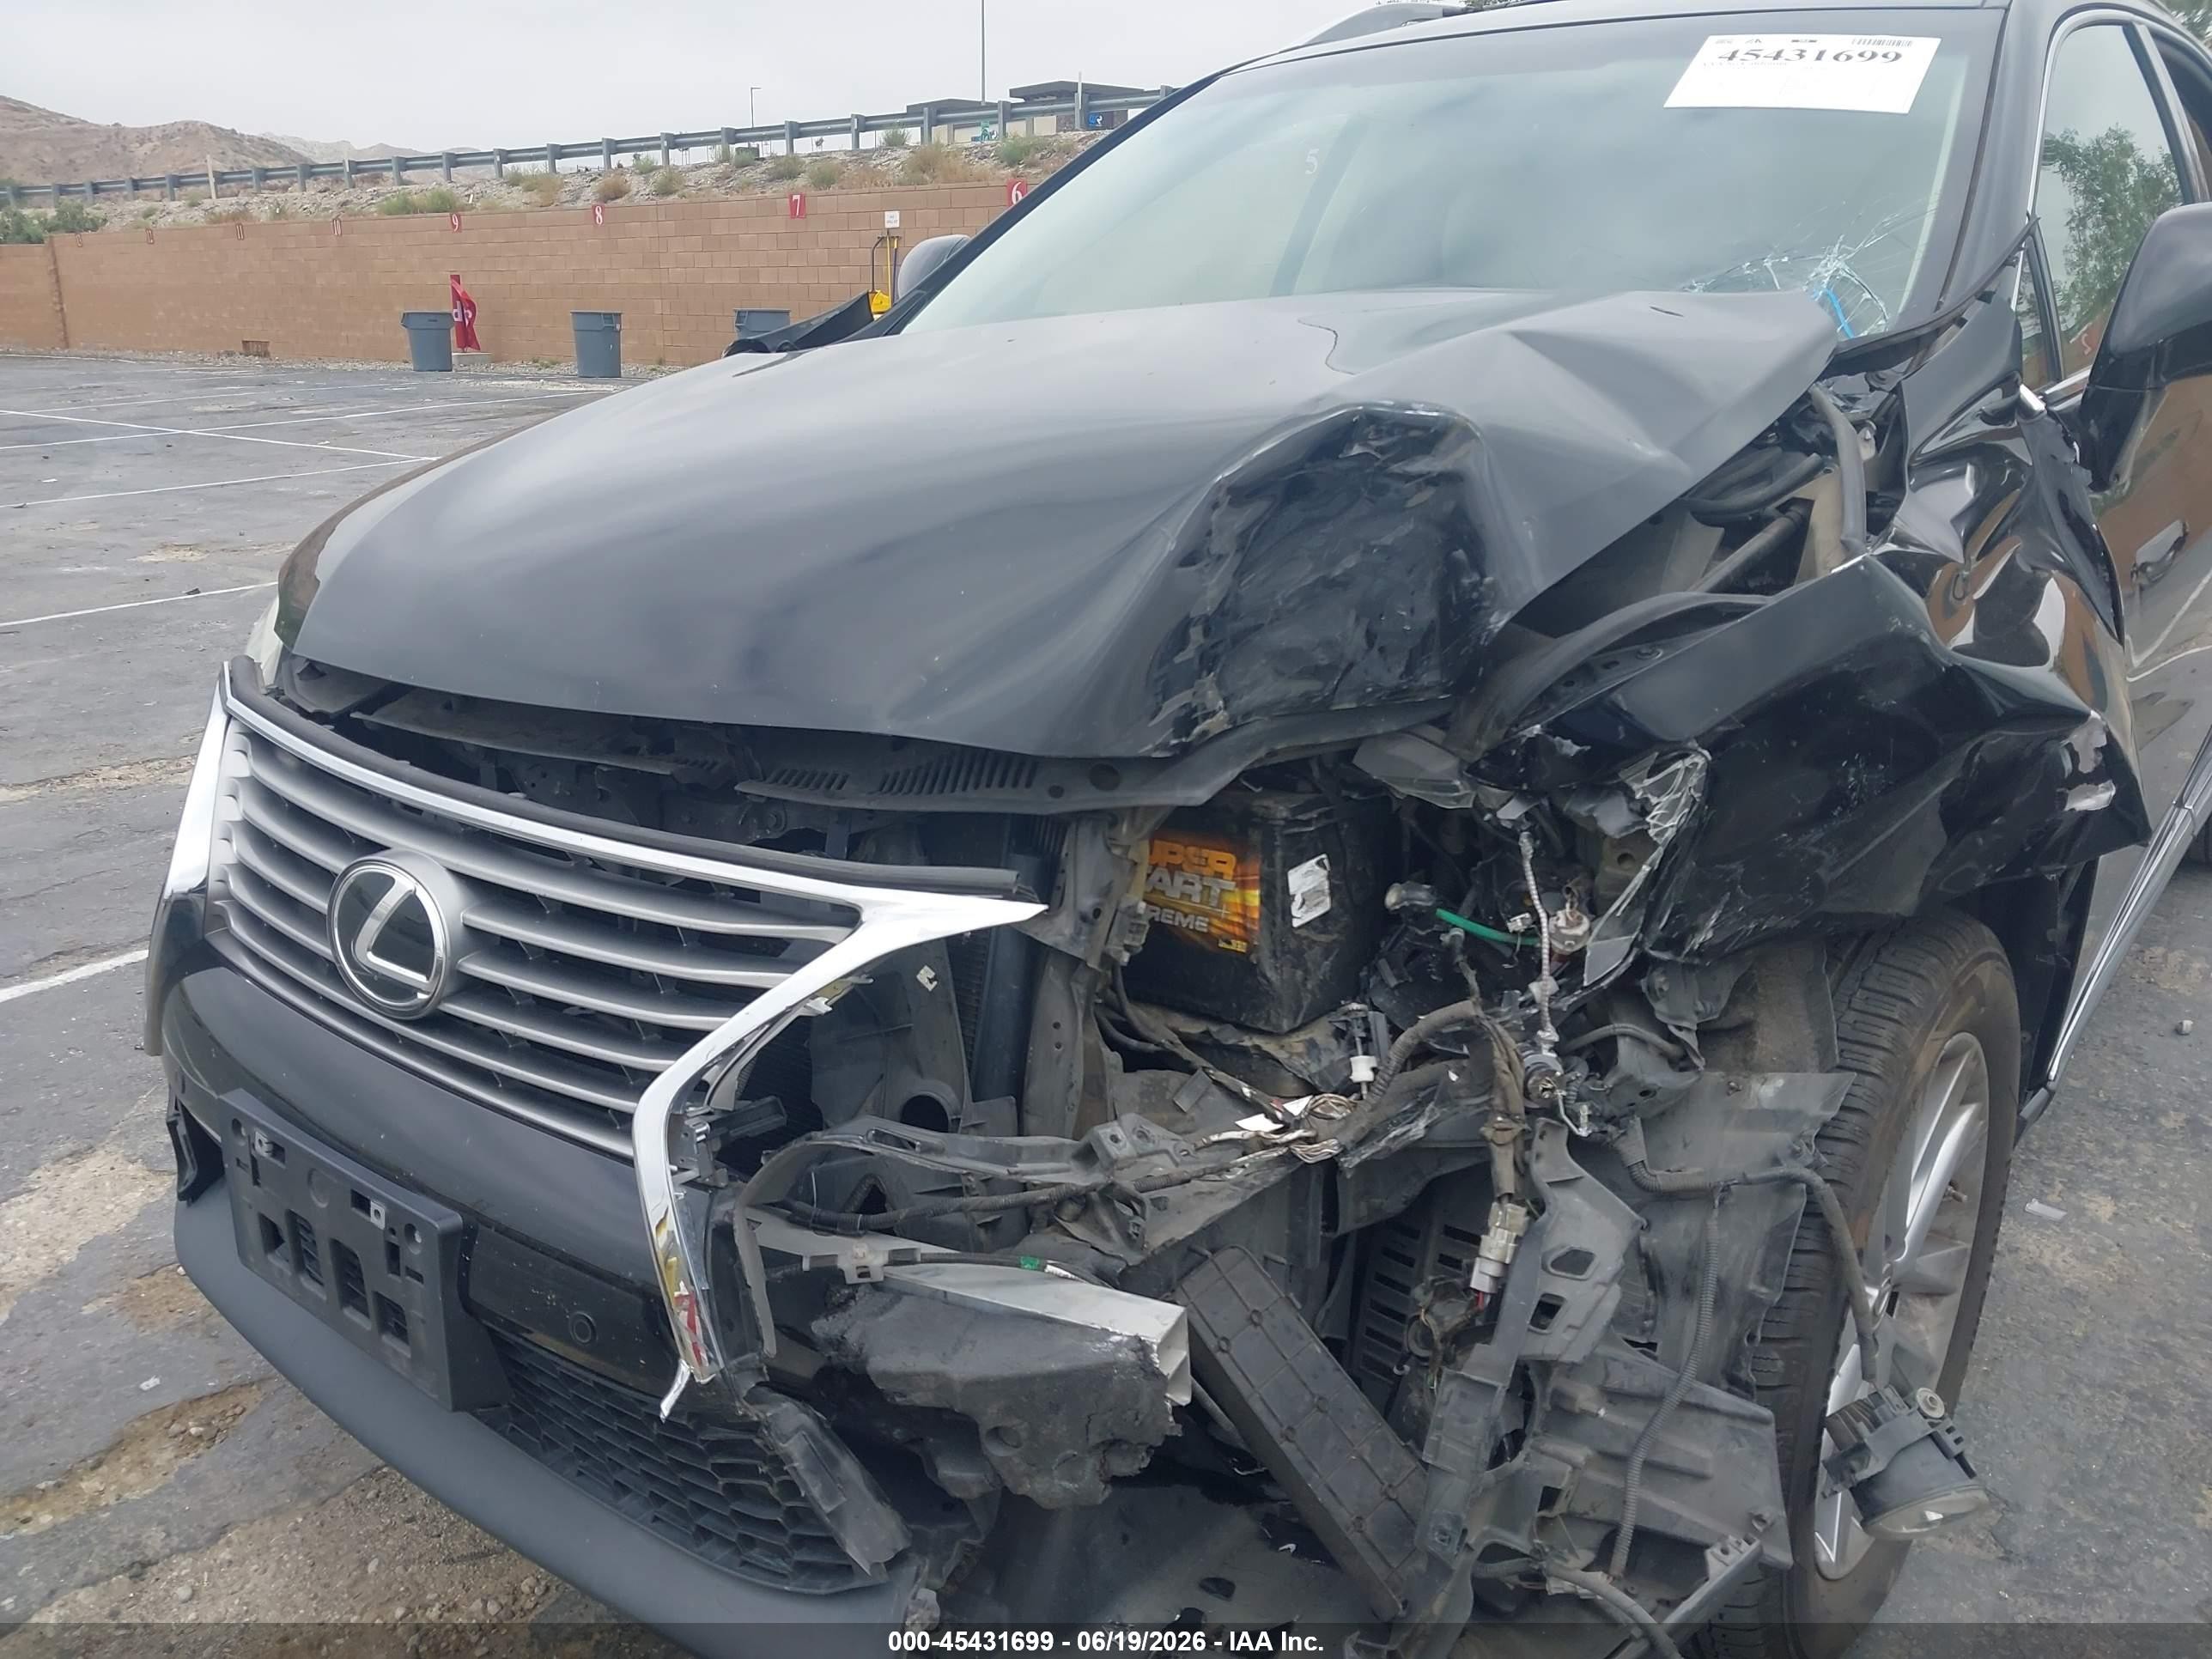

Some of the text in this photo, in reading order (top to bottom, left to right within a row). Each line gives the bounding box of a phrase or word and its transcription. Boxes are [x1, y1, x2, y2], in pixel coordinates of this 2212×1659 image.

[1717, 49, 1904, 64] 45431699
[1305, 149, 1319, 174] 5
[792, 194, 800, 216] 7
[1012, 182, 1023, 205] 6
[452, 214, 459, 232] 9
[595, 205, 603, 225] 8
[1150, 839, 1237, 880] PER
[1146, 866, 1236, 908] ART
[1146, 903, 1210, 933] REME
